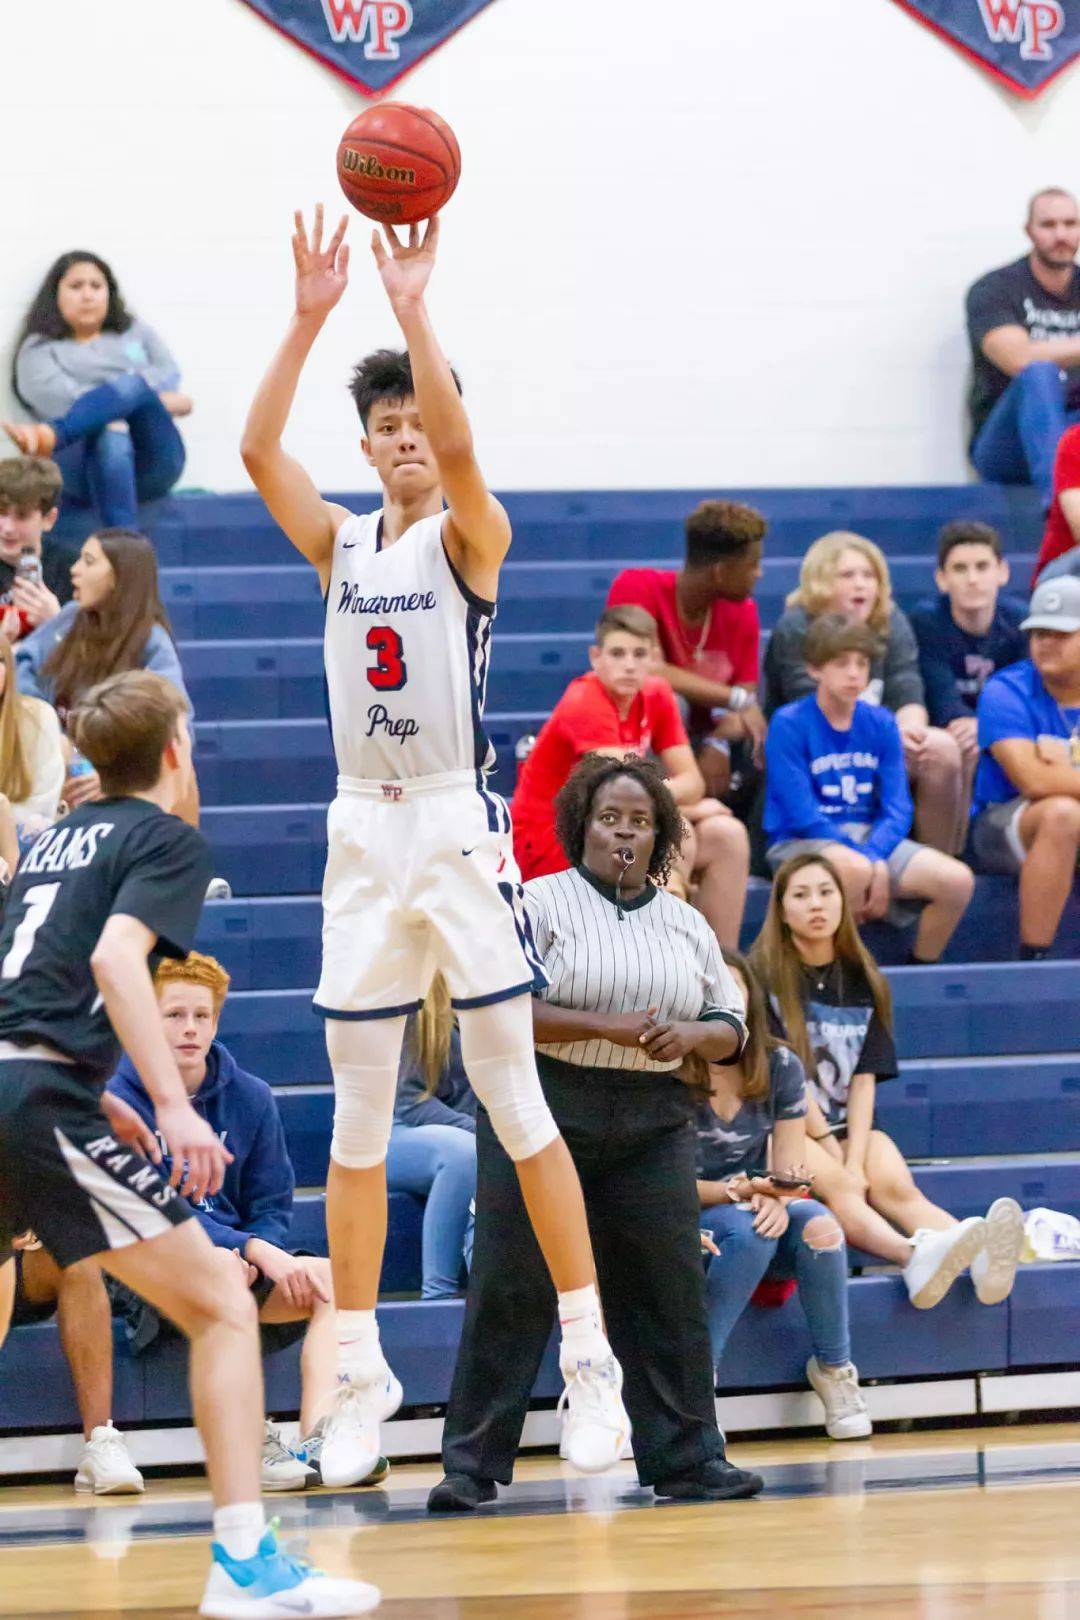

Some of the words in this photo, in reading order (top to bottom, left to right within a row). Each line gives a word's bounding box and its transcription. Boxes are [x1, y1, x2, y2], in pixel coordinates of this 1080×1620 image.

[321, 0, 413, 60] WP
[977, 0, 1065, 61] WP
[342, 148, 415, 185] Wilson
[366, 626, 407, 692] 3
[365, 704, 420, 745] Prep
[18, 823, 115, 874] RAMS
[85, 1135, 178, 1207] RAMS
